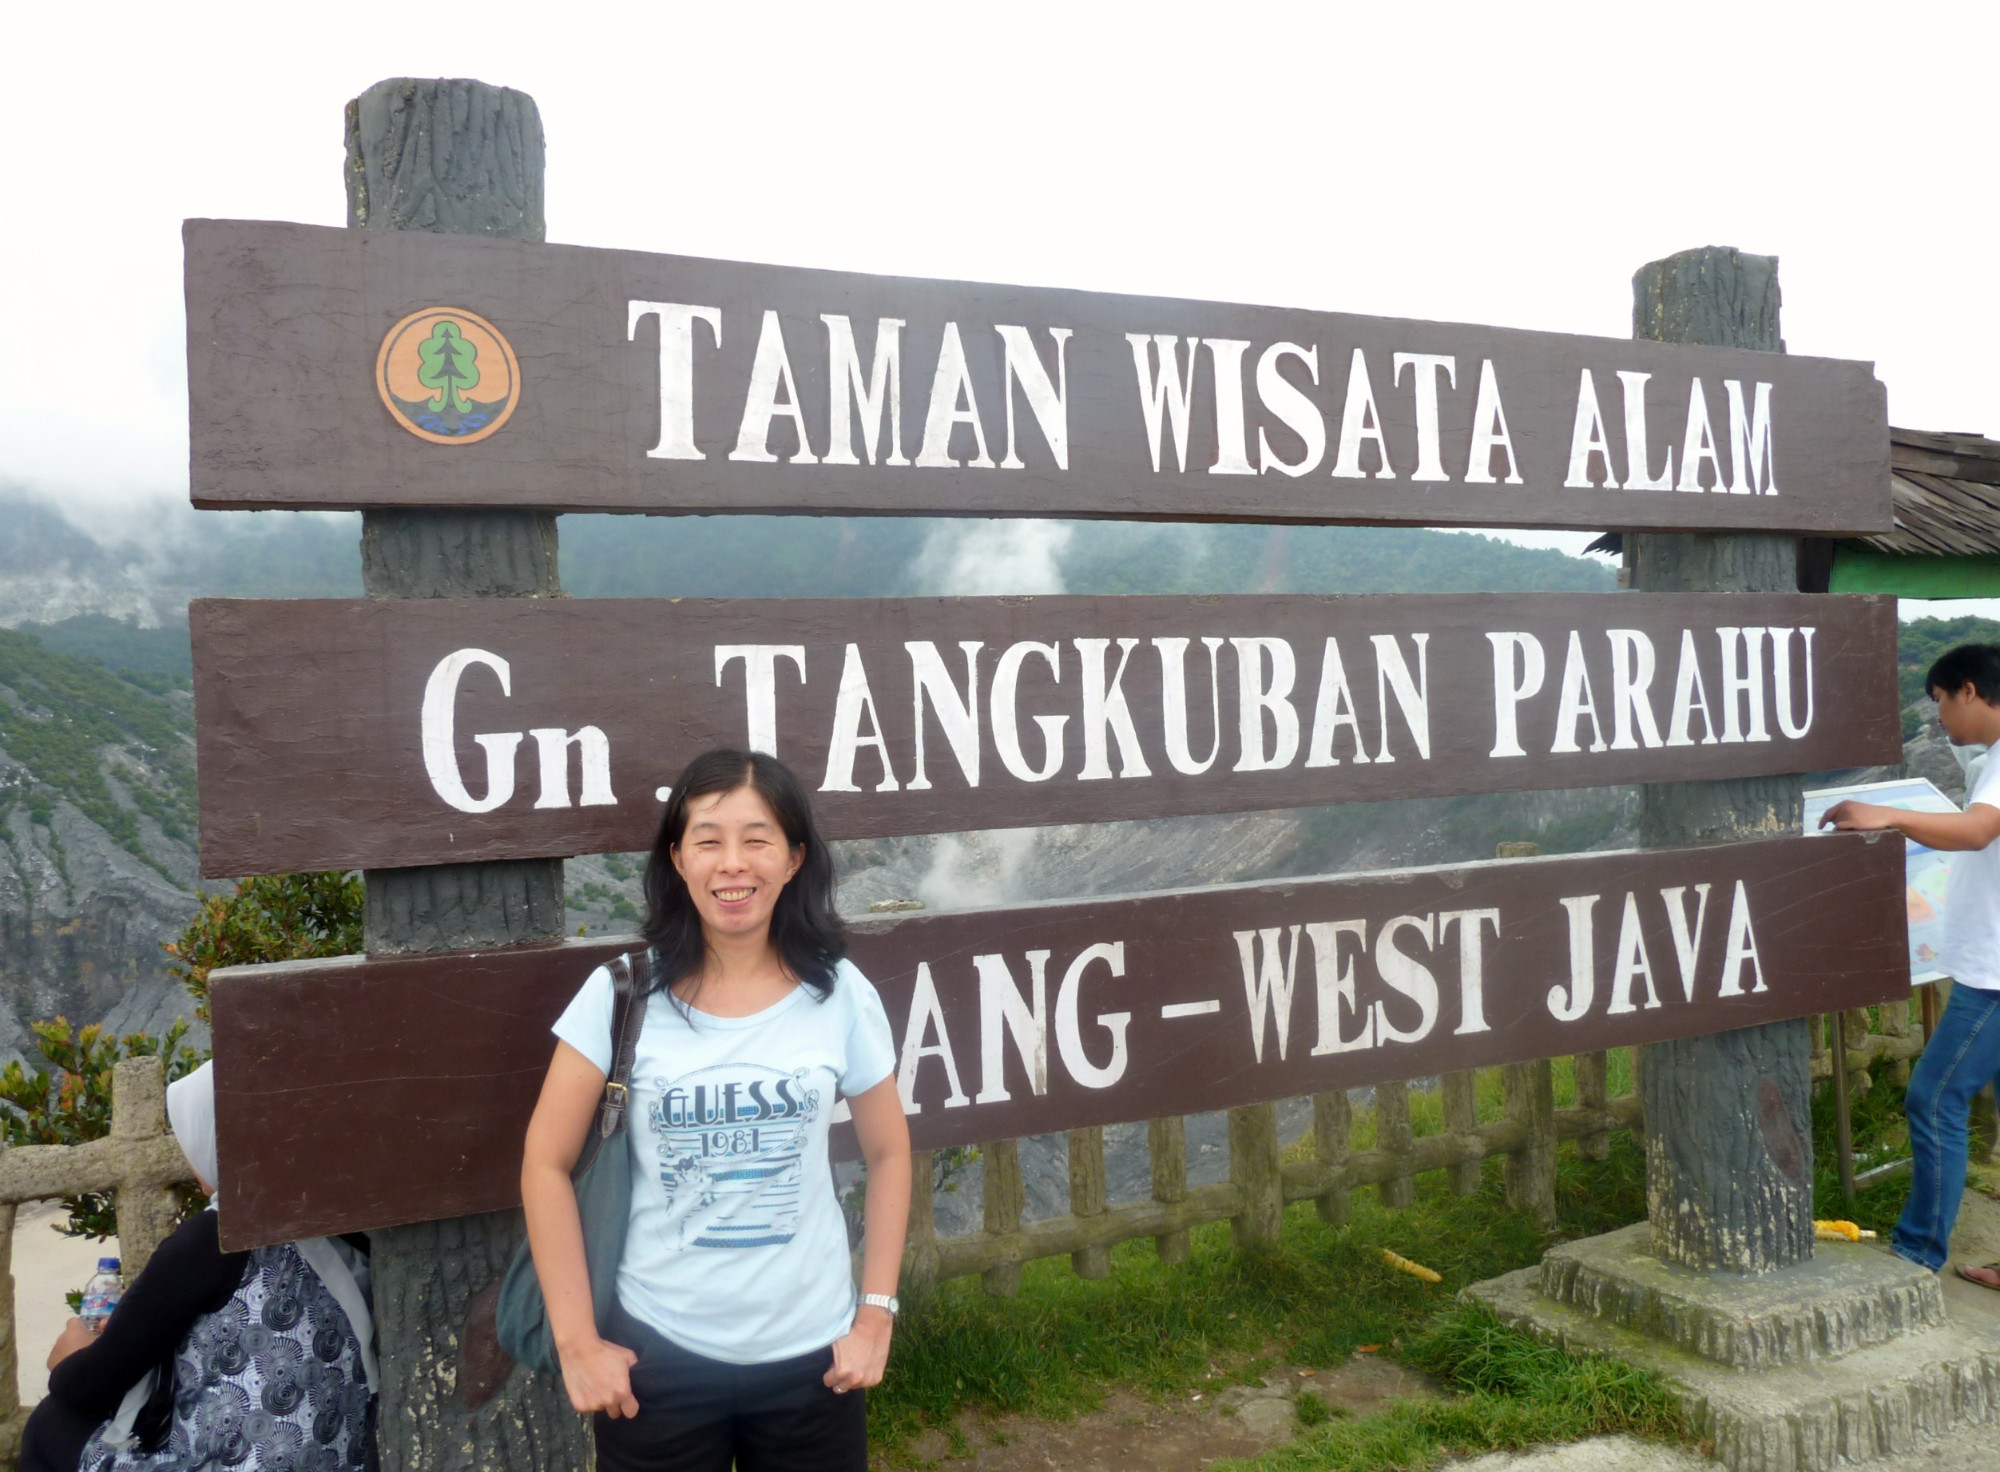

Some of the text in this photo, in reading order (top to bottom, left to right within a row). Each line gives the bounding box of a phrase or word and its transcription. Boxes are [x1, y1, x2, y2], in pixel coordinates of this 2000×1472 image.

[626, 298, 1779, 497] TAMAN WISATA ALAM
[713, 632, 1431, 793] TANGKUBAN
[1484, 626, 1816, 759] PARAHU
[829, 940, 1131, 1124] ANG
[1232, 907, 1500, 1064] WEST
[1546, 879, 1769, 1022] JAVA
[661, 1078, 798, 1128] GUESS
[699, 1128, 760, 1157] 1981
